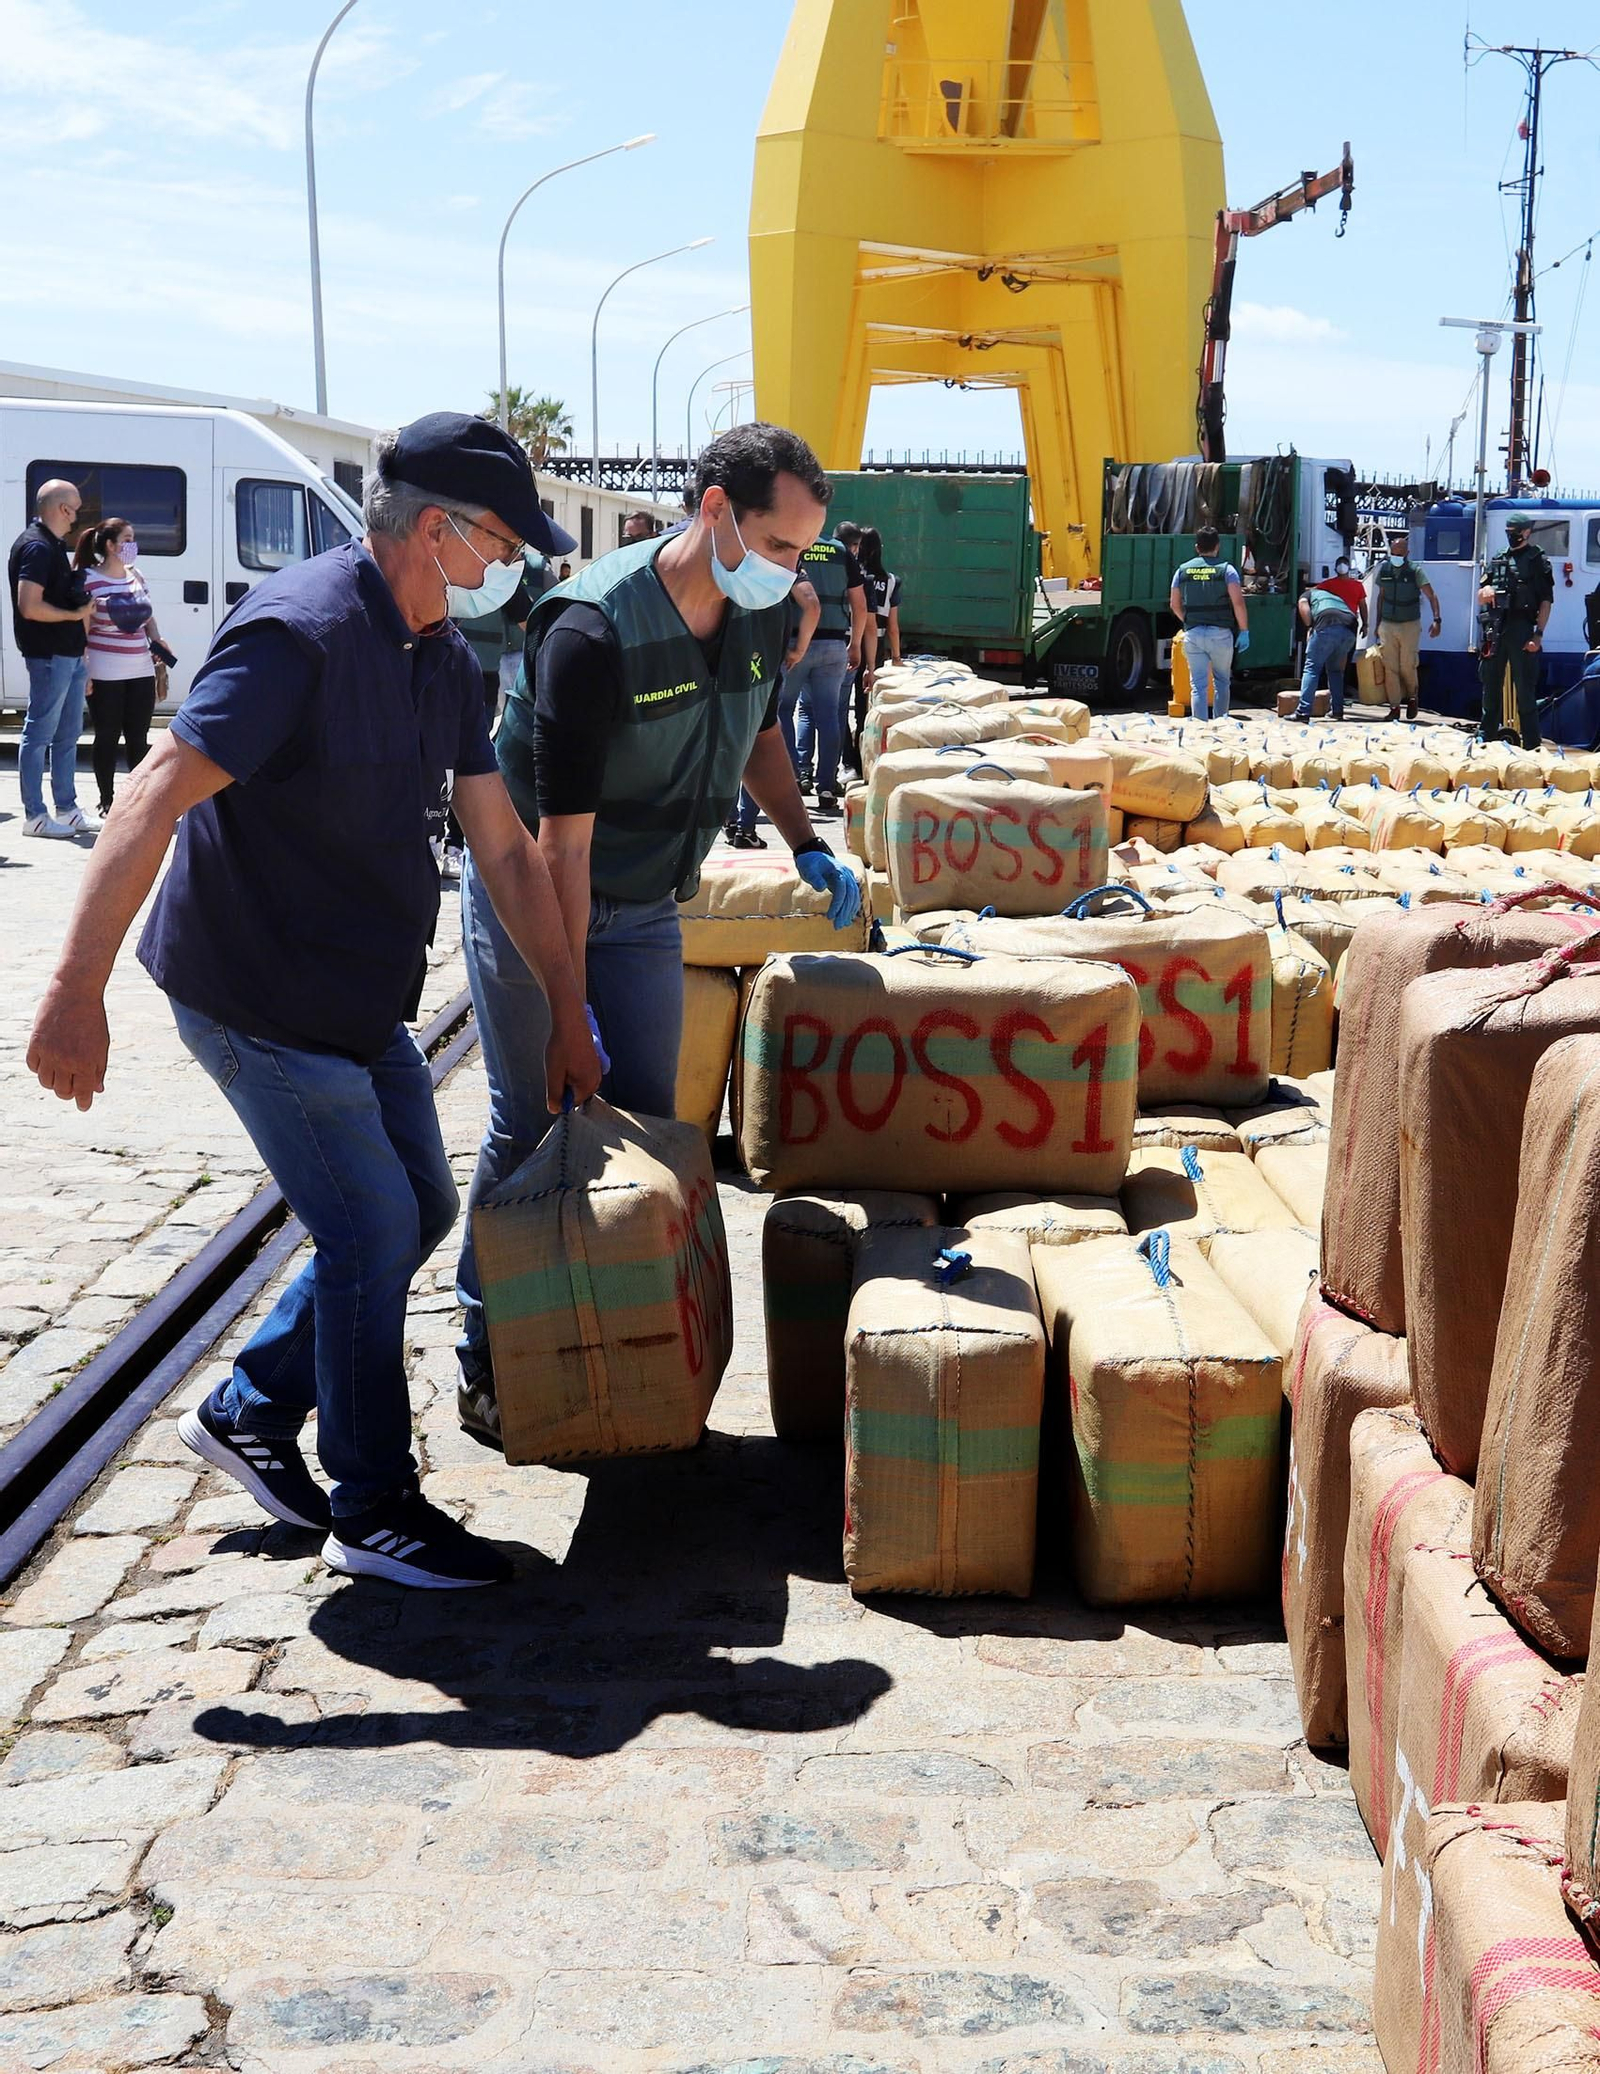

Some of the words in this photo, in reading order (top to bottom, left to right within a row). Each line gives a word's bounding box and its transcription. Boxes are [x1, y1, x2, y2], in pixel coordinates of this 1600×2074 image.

[803, 553, 828, 562] CIVIL
[1186, 567, 1216, 575] GUARDIA
[1055, 664, 1098, 678] IVECO
[674, 681, 698, 695] CIVIL
[912, 805, 1095, 888] BOSS1
[779, 1008, 1116, 1154] BOSS1
